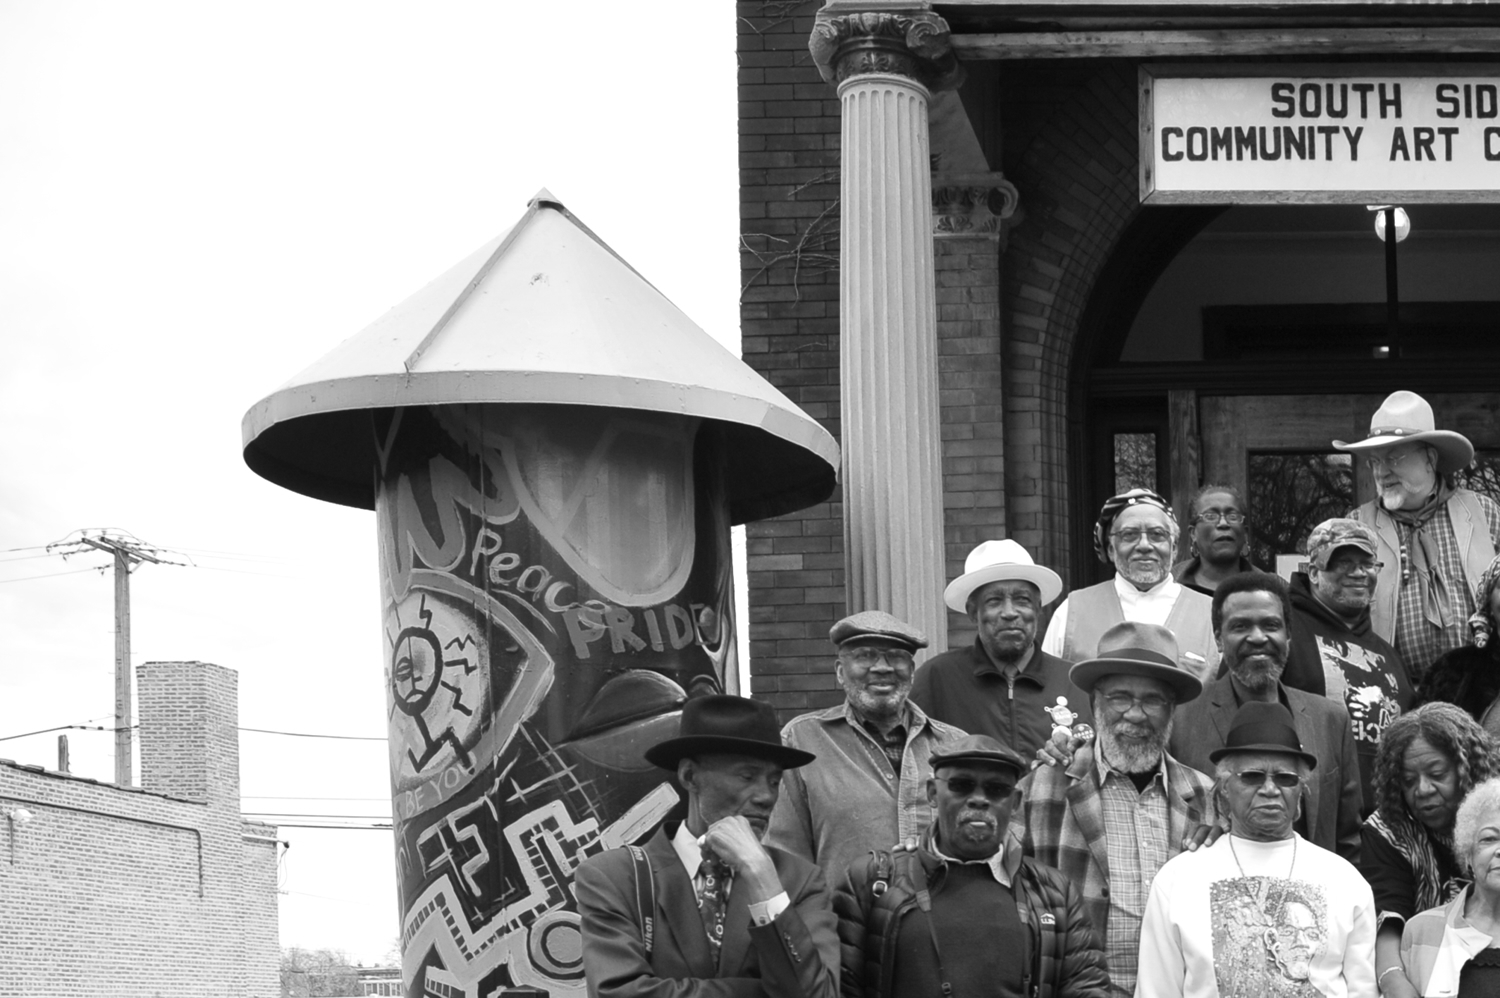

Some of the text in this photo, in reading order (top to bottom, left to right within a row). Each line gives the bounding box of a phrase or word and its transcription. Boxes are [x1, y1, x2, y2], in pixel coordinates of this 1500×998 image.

[1270, 82, 1402, 119] SOUTH
[1161, 126, 1364, 162] COMMUNITY
[1389, 126, 1460, 162] ART
[562, 603, 711, 659] PRIDE
[644, 916, 653, 953] Nikon
